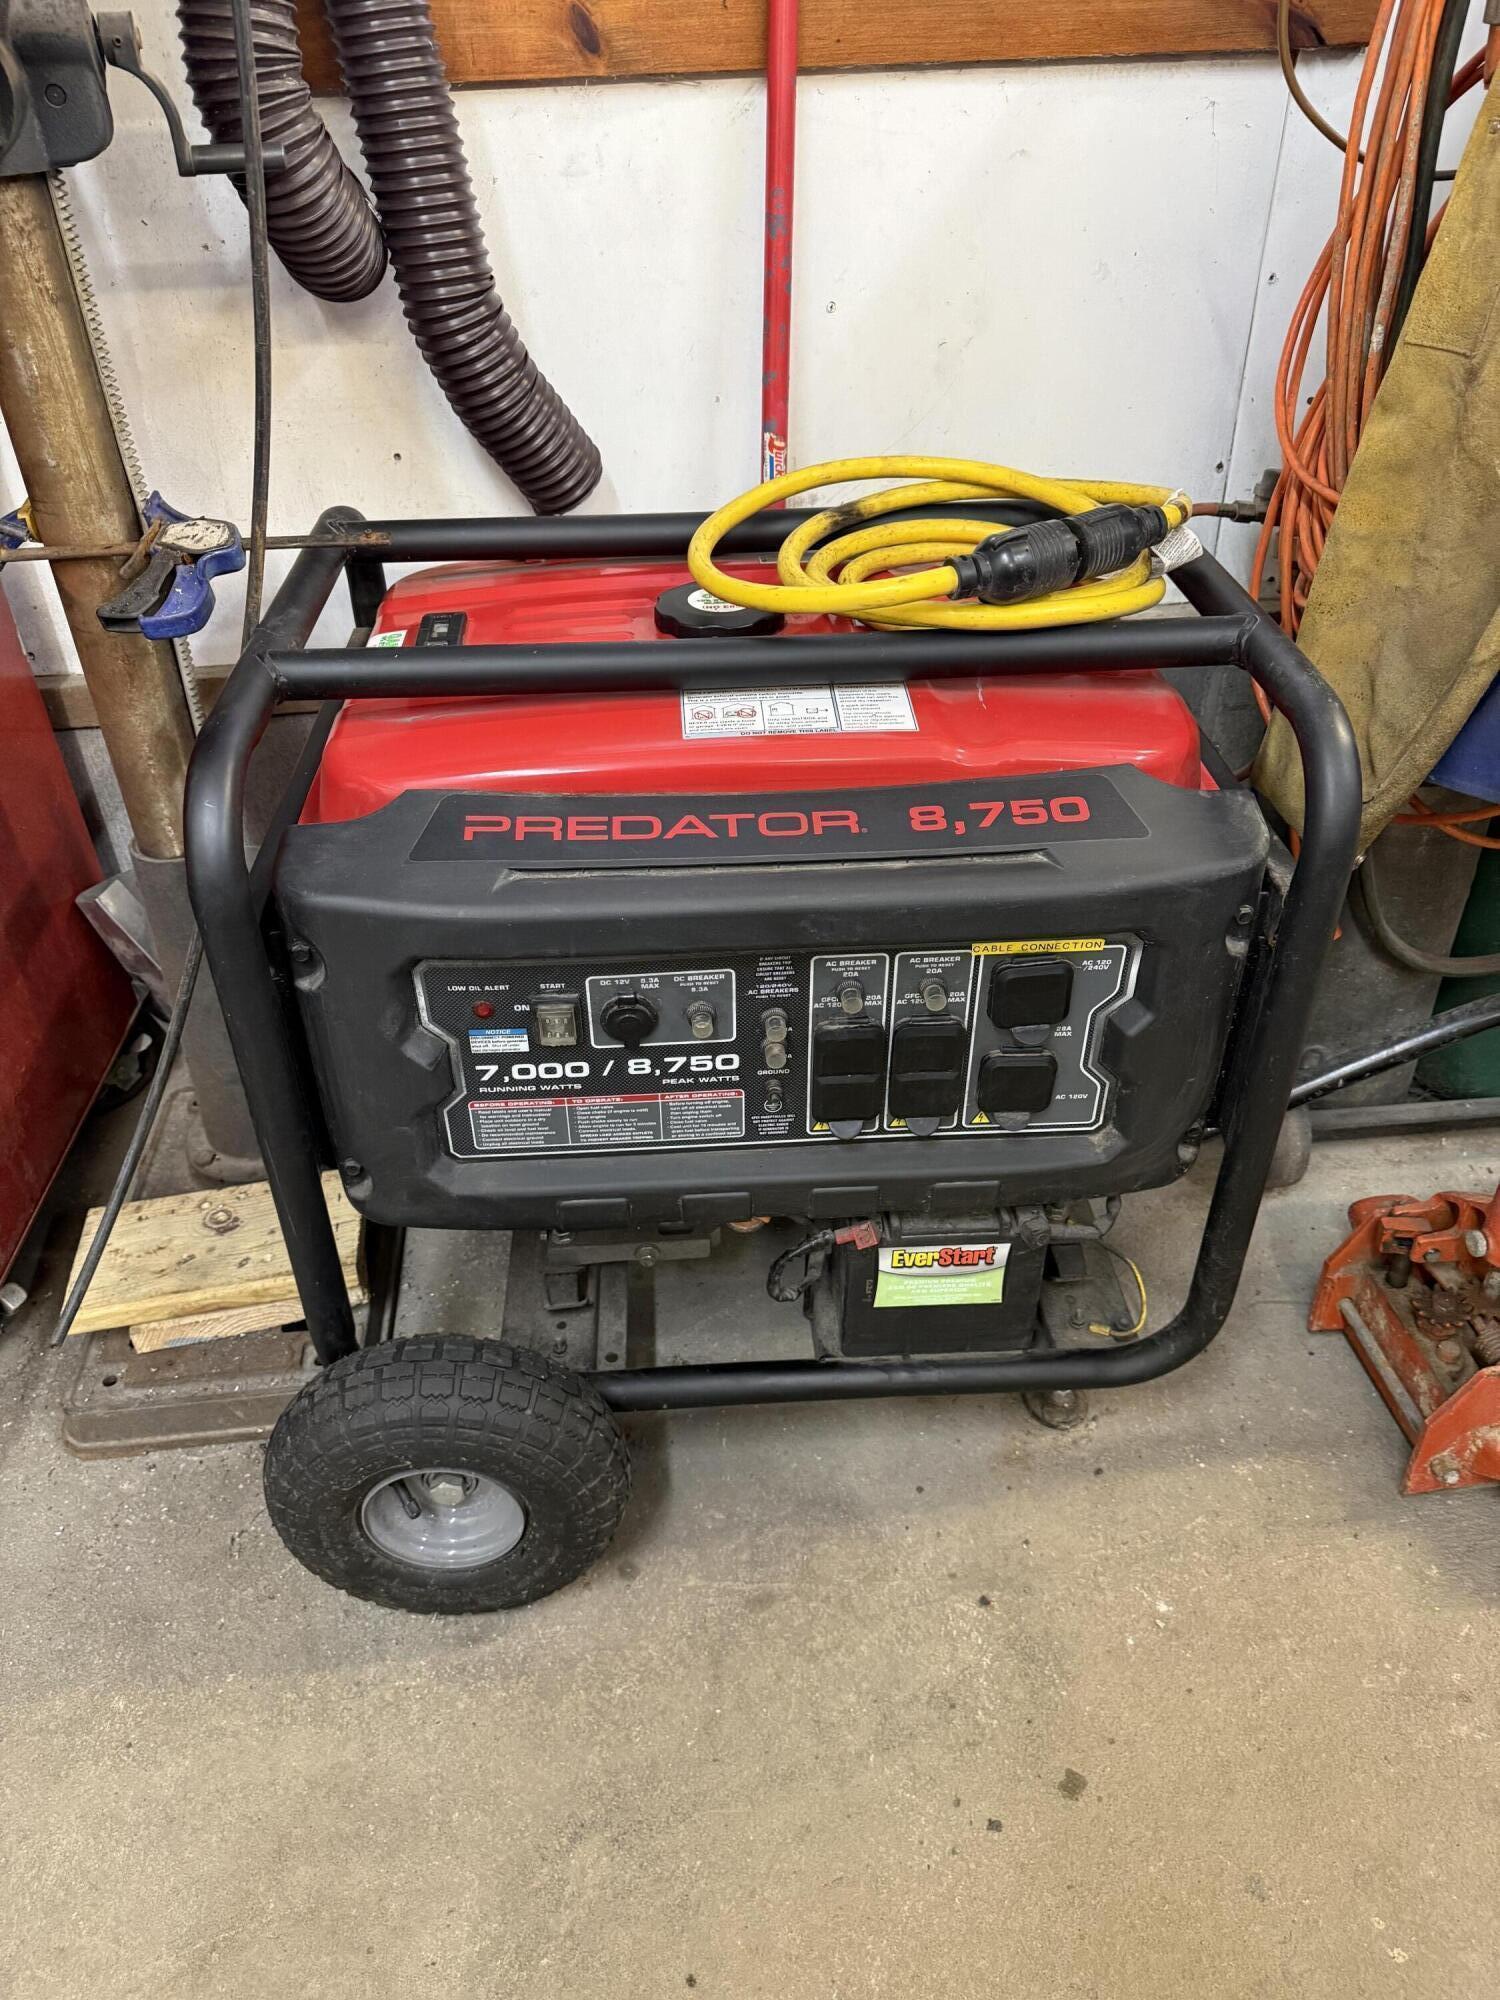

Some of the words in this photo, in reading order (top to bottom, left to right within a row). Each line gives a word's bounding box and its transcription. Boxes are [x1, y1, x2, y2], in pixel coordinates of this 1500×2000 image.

[463, 810, 859, 841] PREDATOR
[909, 797, 1091, 836] 8,750
[973, 944, 1013, 953] CABLE
[1021, 941, 1102, 951] CONNECTION
[475, 1062, 590, 1082] 7,000
[602, 1060, 614, 1076] /
[627, 1054, 740, 1076] 8,750
[479, 1084, 536, 1093] RUNNING
[890, 1246, 995, 1268] EverStart
